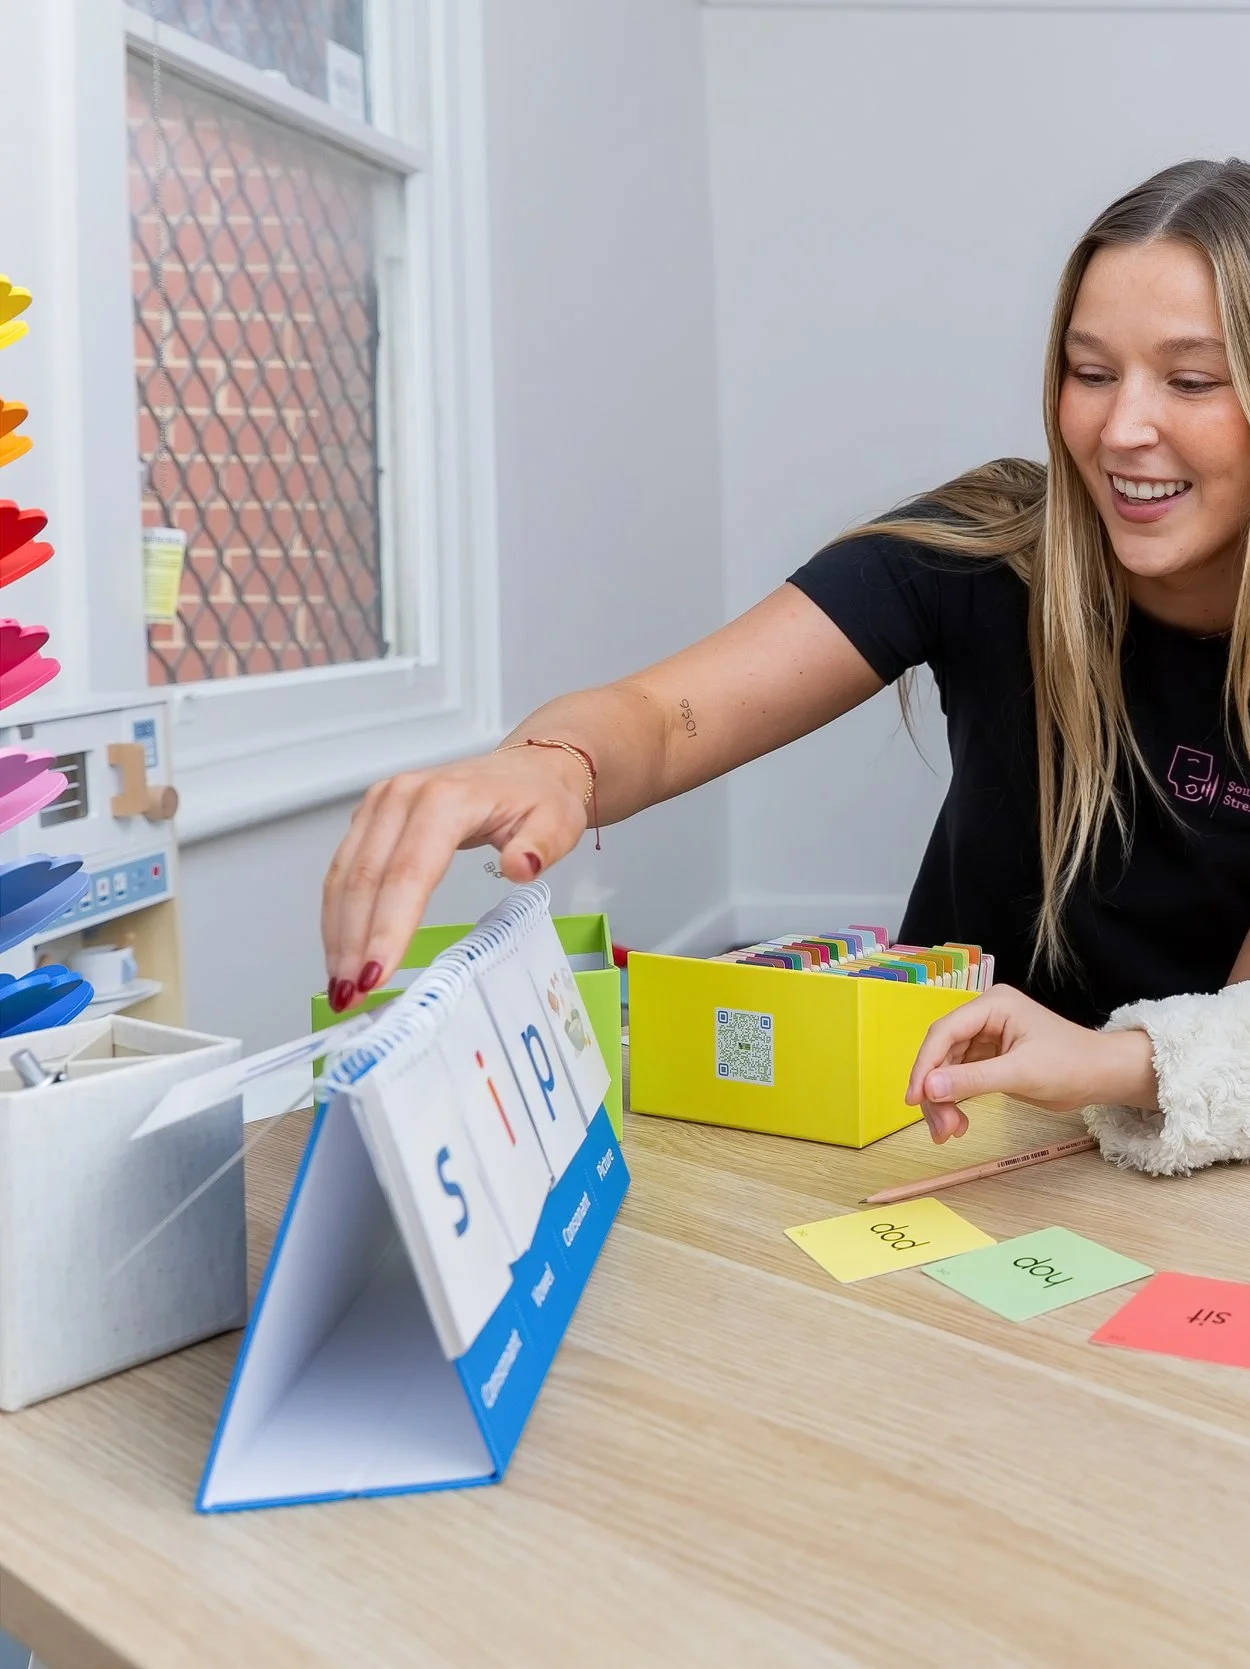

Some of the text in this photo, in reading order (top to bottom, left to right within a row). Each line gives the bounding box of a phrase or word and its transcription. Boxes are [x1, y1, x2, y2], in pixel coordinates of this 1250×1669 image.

[436, 1024, 556, 1237] s i p
[597, 1148, 614, 1181] Picture
[871, 1223, 930, 1251] pop
[1013, 1257, 1073, 1289] hop
[1187, 1309, 1232, 1326] sit
